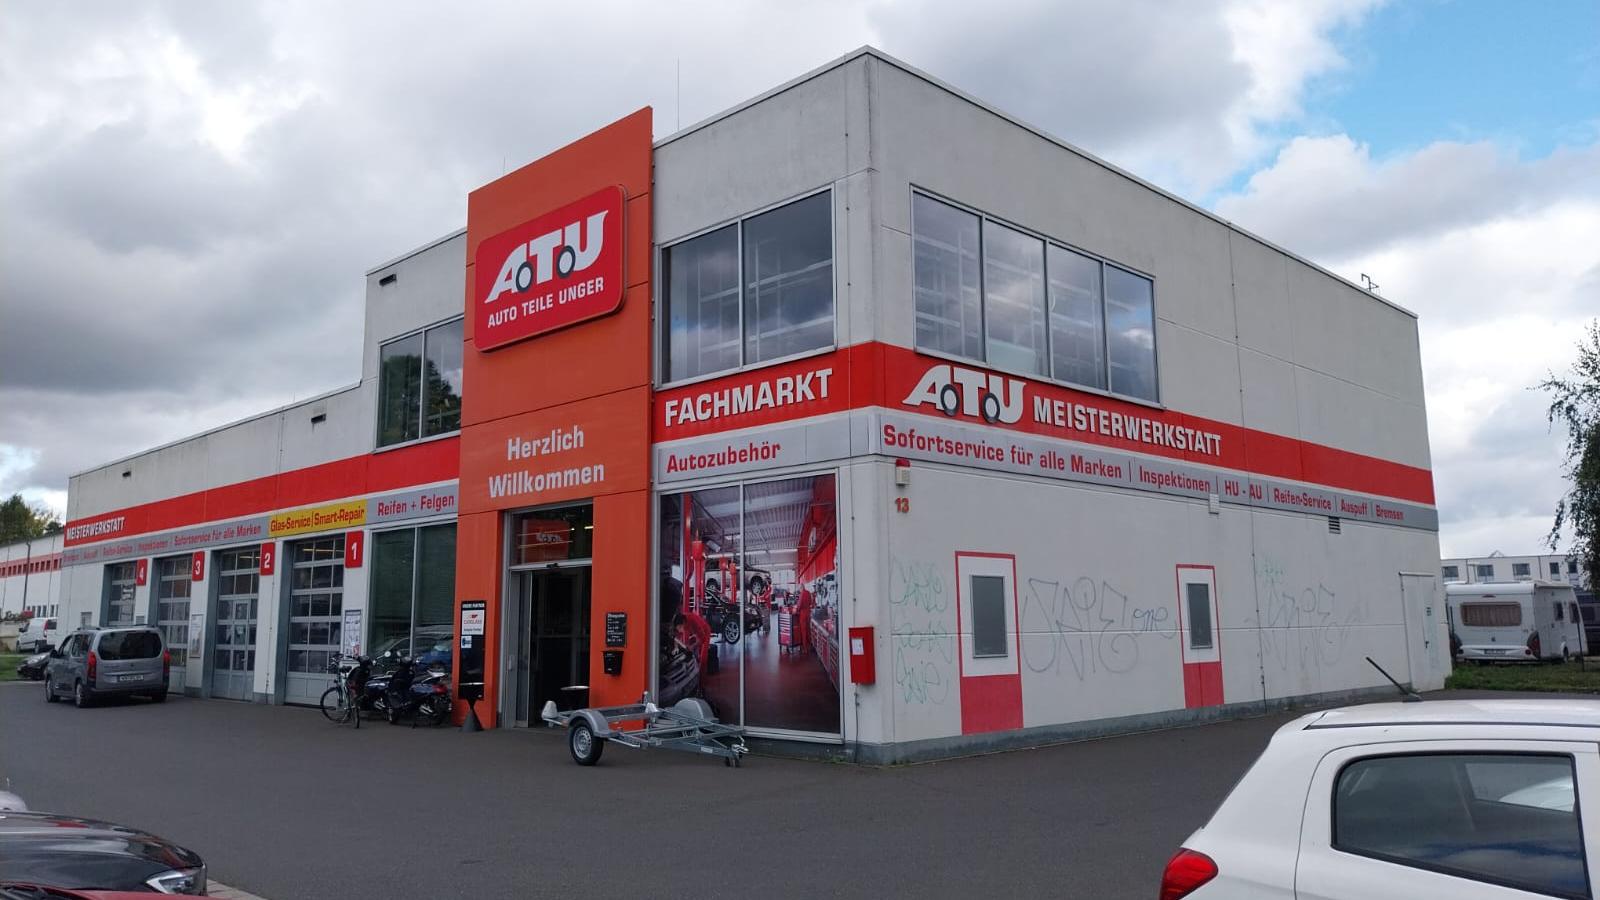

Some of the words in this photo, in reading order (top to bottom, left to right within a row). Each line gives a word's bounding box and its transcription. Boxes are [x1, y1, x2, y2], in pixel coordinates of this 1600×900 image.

[487, 305, 517, 328] AUTO
[521, 293, 553, 317] TEILE
[558, 276, 604, 305] UNGER
[664, 367, 834, 428] FACHMARKT
[1033, 395, 1222, 458] MEISTERWERKSTATT
[507, 424, 584, 461] Herzlich
[883, 424, 1004, 462] Sofortservice
[1010, 446, 1034, 467] für
[1039, 450, 1066, 471] alle
[1071, 454, 1122, 479] Marken
[666, 441, 781, 474] Autozubehör
[488, 463, 605, 498] Willkommen
[1139, 465, 1210, 493] Inspektionen
[1224, 482, 1239, 497] HU
[1249, 484, 1262, 500] AU
[1273, 488, 1332, 511] Reifen-Service
[377, 501, 407, 517] Reifen
[420, 494, 454, 513] Felgen
[895, 497, 909, 513] 13
[1340, 499, 1368, 515] Auspuff
[1375, 505, 1404, 521] Bremsen
[66, 517, 125, 541] MEISTERWERKSTATT
[237, 525, 261, 537] Marken
[264, 552, 271, 569] 2
[351, 542, 358, 560] 1
[139, 567, 144, 580] 4
[195, 560, 201, 575] 3
